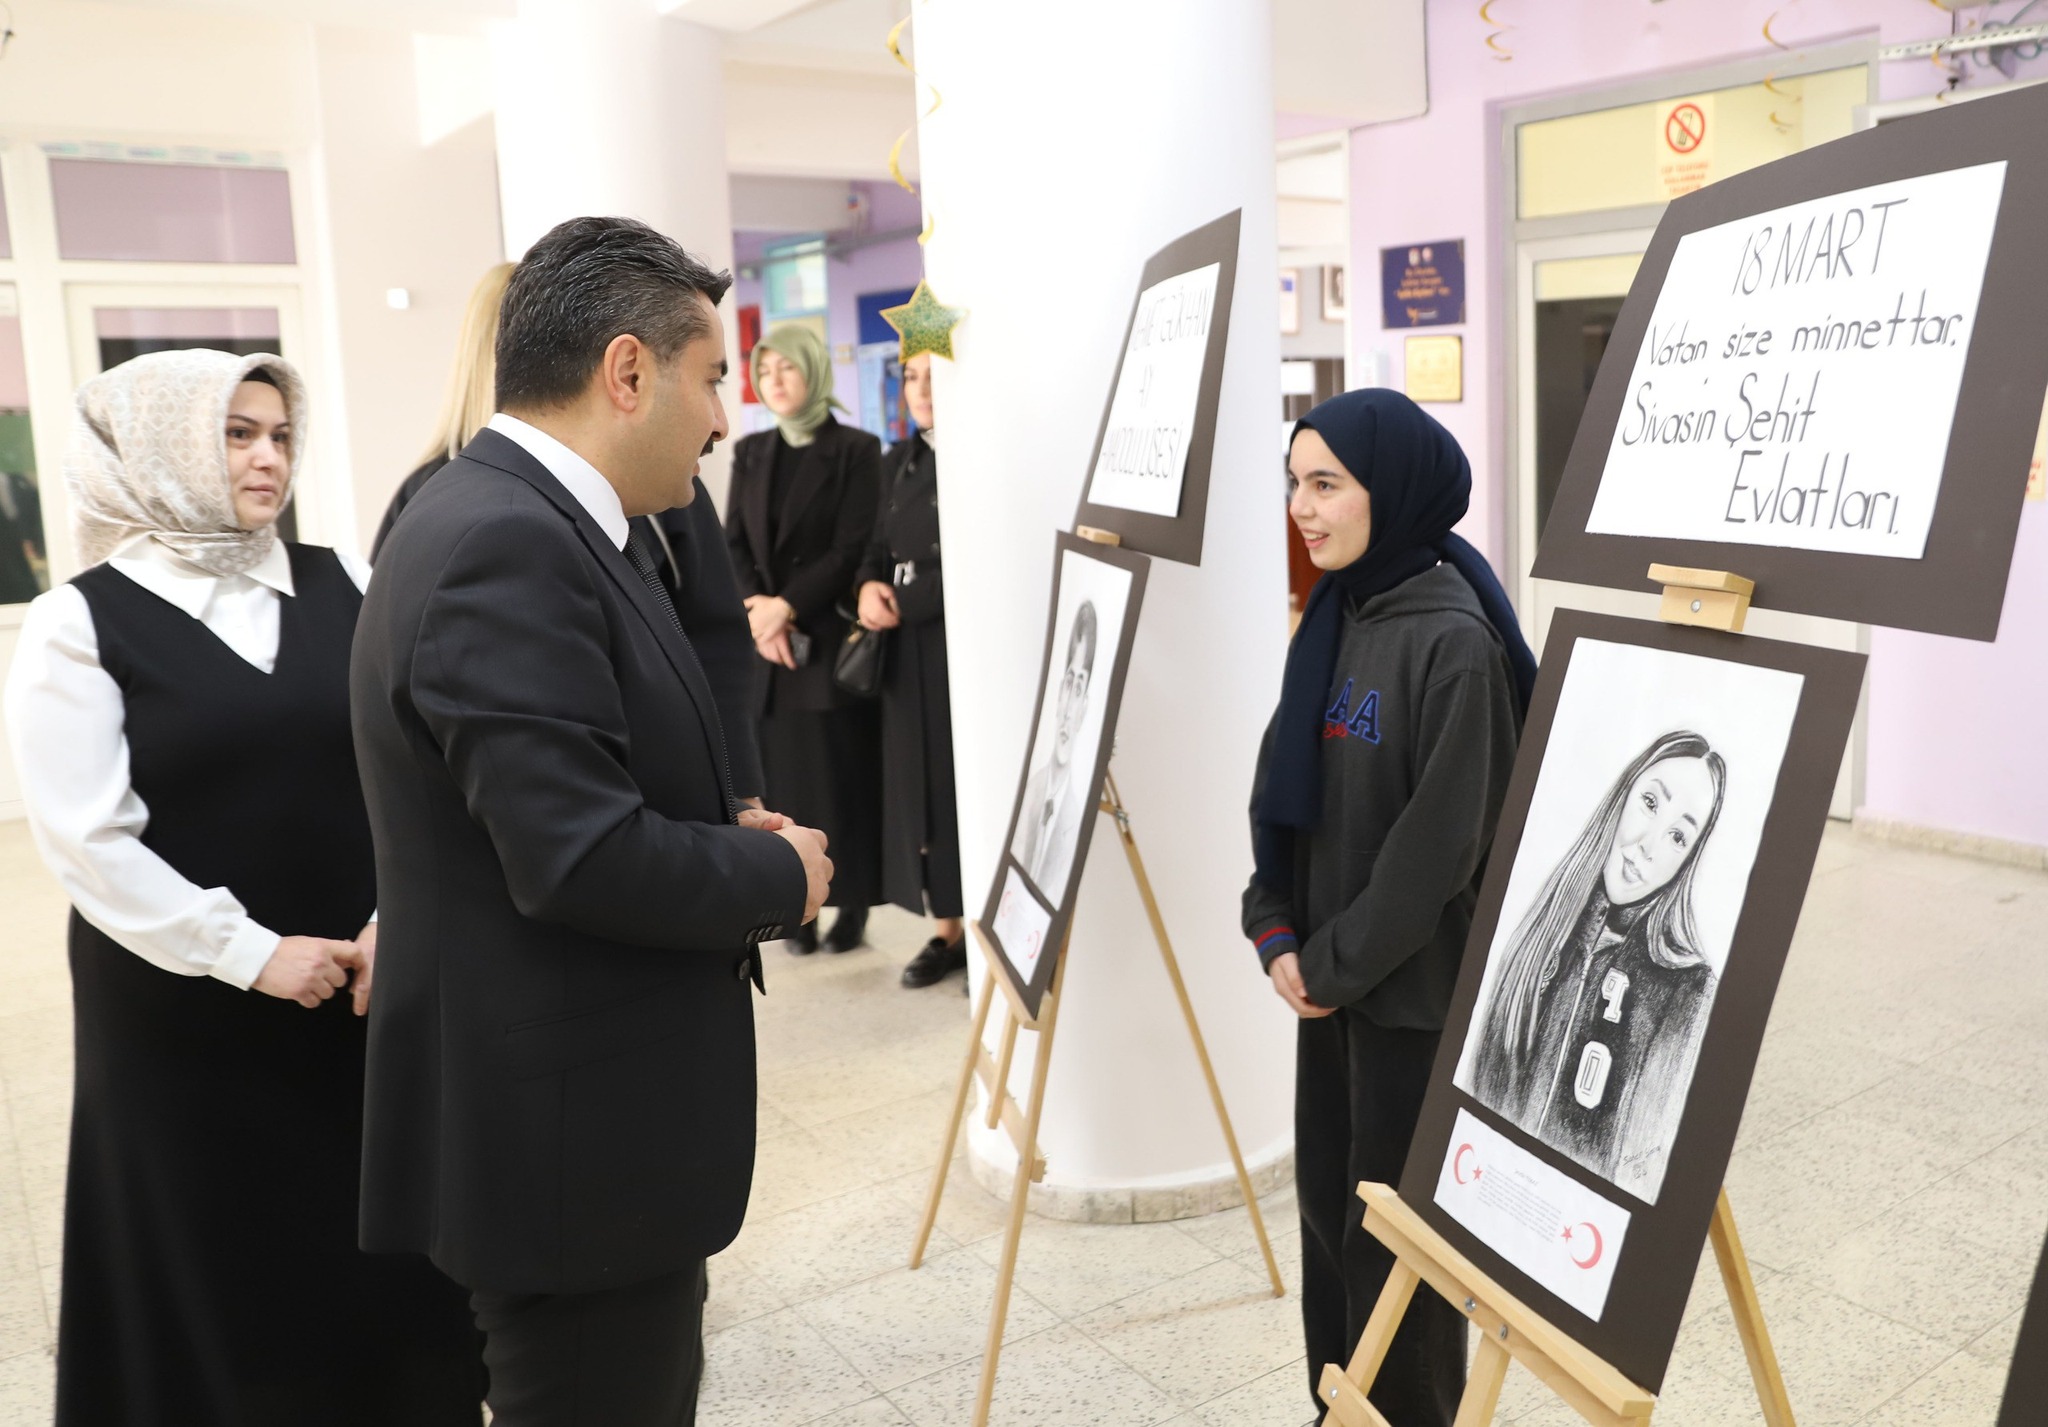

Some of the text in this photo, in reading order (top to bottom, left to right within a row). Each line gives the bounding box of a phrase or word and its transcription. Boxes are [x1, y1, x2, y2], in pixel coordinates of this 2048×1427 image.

[1732, 197, 1909, 296] 18 MART
[1650, 288, 1963, 366] Vatan size minnettar.
[1724, 370, 1821, 449] Şehit
[1724, 449, 1899, 535] Evlatları.
